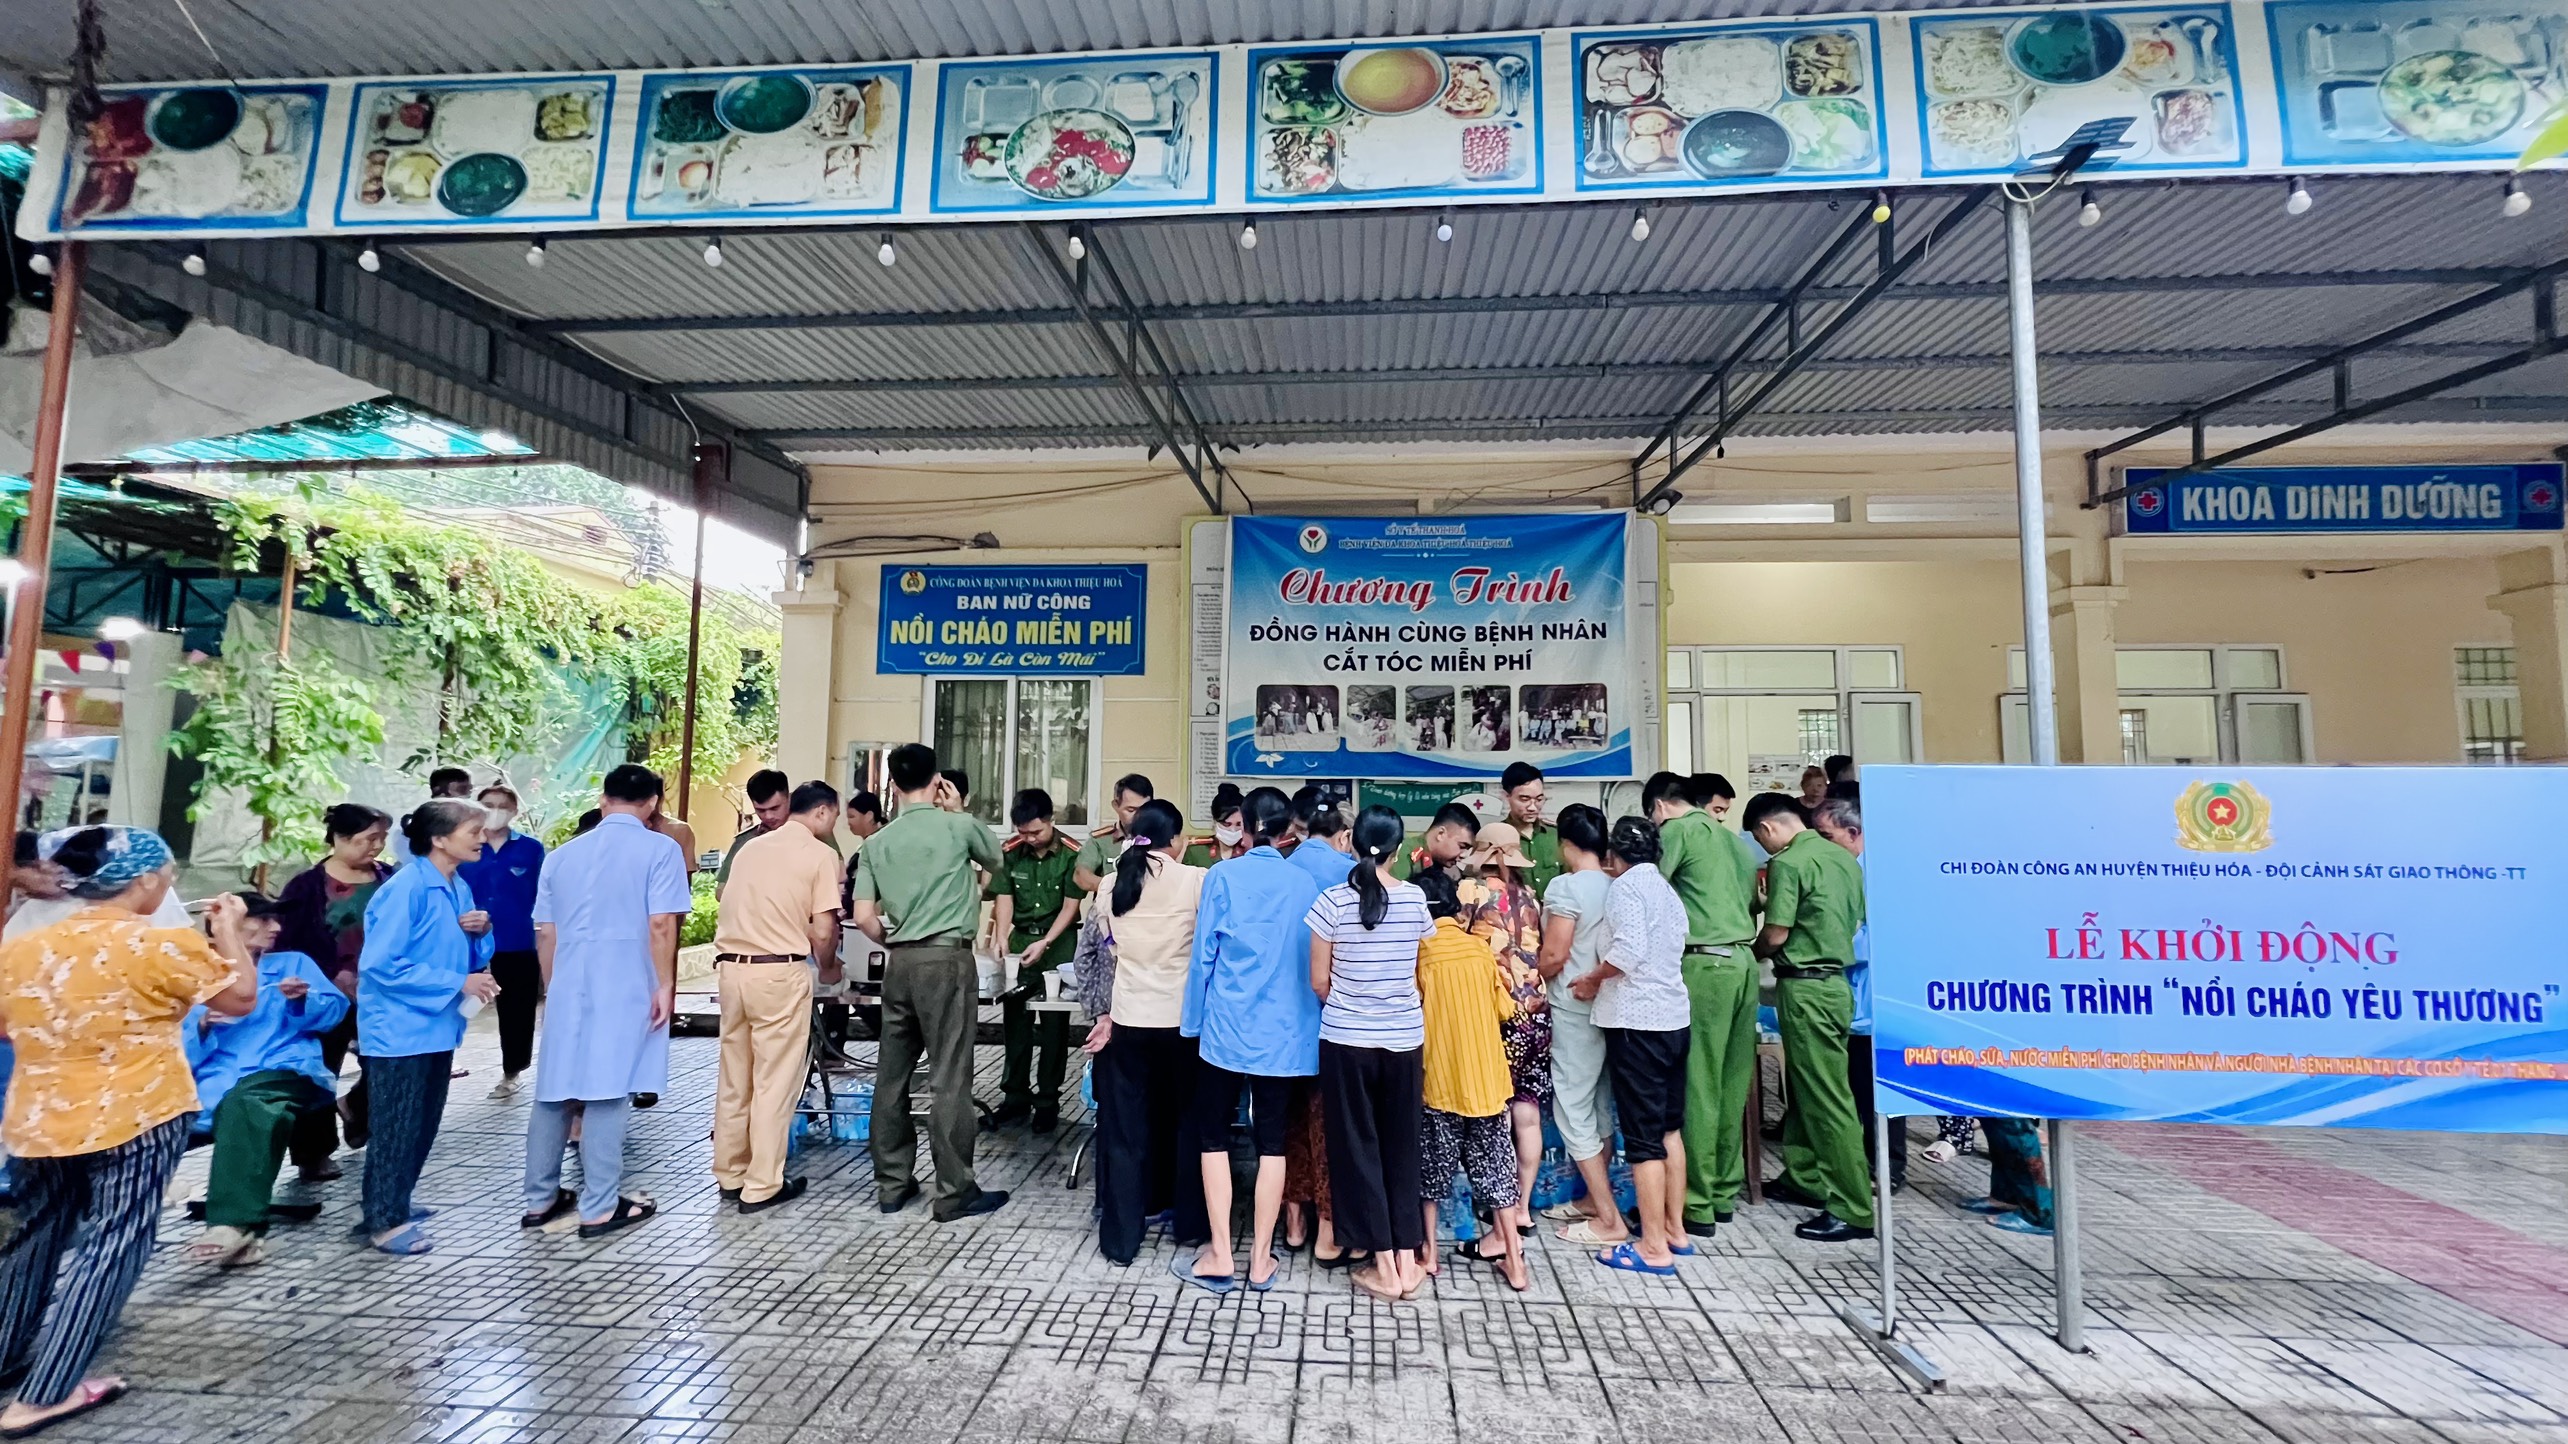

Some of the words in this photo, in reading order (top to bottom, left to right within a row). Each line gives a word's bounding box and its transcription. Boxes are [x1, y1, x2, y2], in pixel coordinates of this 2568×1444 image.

[2183, 485, 2275, 521] KHOA
[2286, 484, 2370, 520] DINH
[2381, 474, 2502, 520] DƯỠNG
[957, 595, 997, 610] BAN
[1003, 593, 1033, 610] NỮ
[1037, 592, 1091, 610] CÔNG
[1280, 568, 1435, 613] Chương
[1451, 566, 1574, 604] Trình
[941, 615, 1008, 645] CHÁO
[1015, 612, 1081, 645] MIỄN
[1089, 615, 1132, 645] PHÍ
[1250, 617, 1318, 642] ĐỒNG
[1326, 621, 1390, 642] HÀNH
[1398, 620, 1466, 643] CÙNG
[1475, 621, 1534, 647] BỆNH
[1542, 618, 1607, 641] NHÂN
[1323, 646, 1369, 672] CẮT
[1375, 650, 1423, 672] TÓC
[1431, 647, 1486, 672] MIỄN
[1494, 648, 1533, 671] PHÍ
[1940, 861, 1967, 875] CHI
[1971, 860, 2019, 875] ĐOÀN
[2023, 860, 2070, 875] CÔNG
[2074, 863, 2097, 875] AN
[2102, 861, 2157, 880] HUYỆN
[2161, 861, 2210, 880] THIỆU
[2215, 861, 2252, 877] HÓA
[2265, 862, 2296, 881] ĐỘI
[2301, 861, 2349, 878] CẢNH
[2353, 863, 2383, 878] SÁT
[2388, 865, 2431, 879] GIAO
[2434, 865, 2497, 880] THÔNG
[2045, 911, 2105, 960] LỄ
[2119, 918, 2244, 962] KHỞI
[2256, 920, 2399, 973] ĐỘNG
[1926, 979, 2051, 1014] CHƯƠNG
[2060, 977, 2153, 1016] TRÌNH
[2247, 981, 2331, 1019] CHÁO
[2341, 982, 2403, 1021] YÊU
[1905, 1046, 1938, 1066] (PHÁT
[2048, 1046, 2079, 1068] MIỄN
[2080, 1049, 2102, 1069] PHÍ
[2104, 1051, 2131, 1069] CHO
[2131, 1050, 2167, 1073] BỆNH
[2168, 1050, 2204, 1071] NHÂN
[2299, 1053, 2334, 1077] BỆNH
